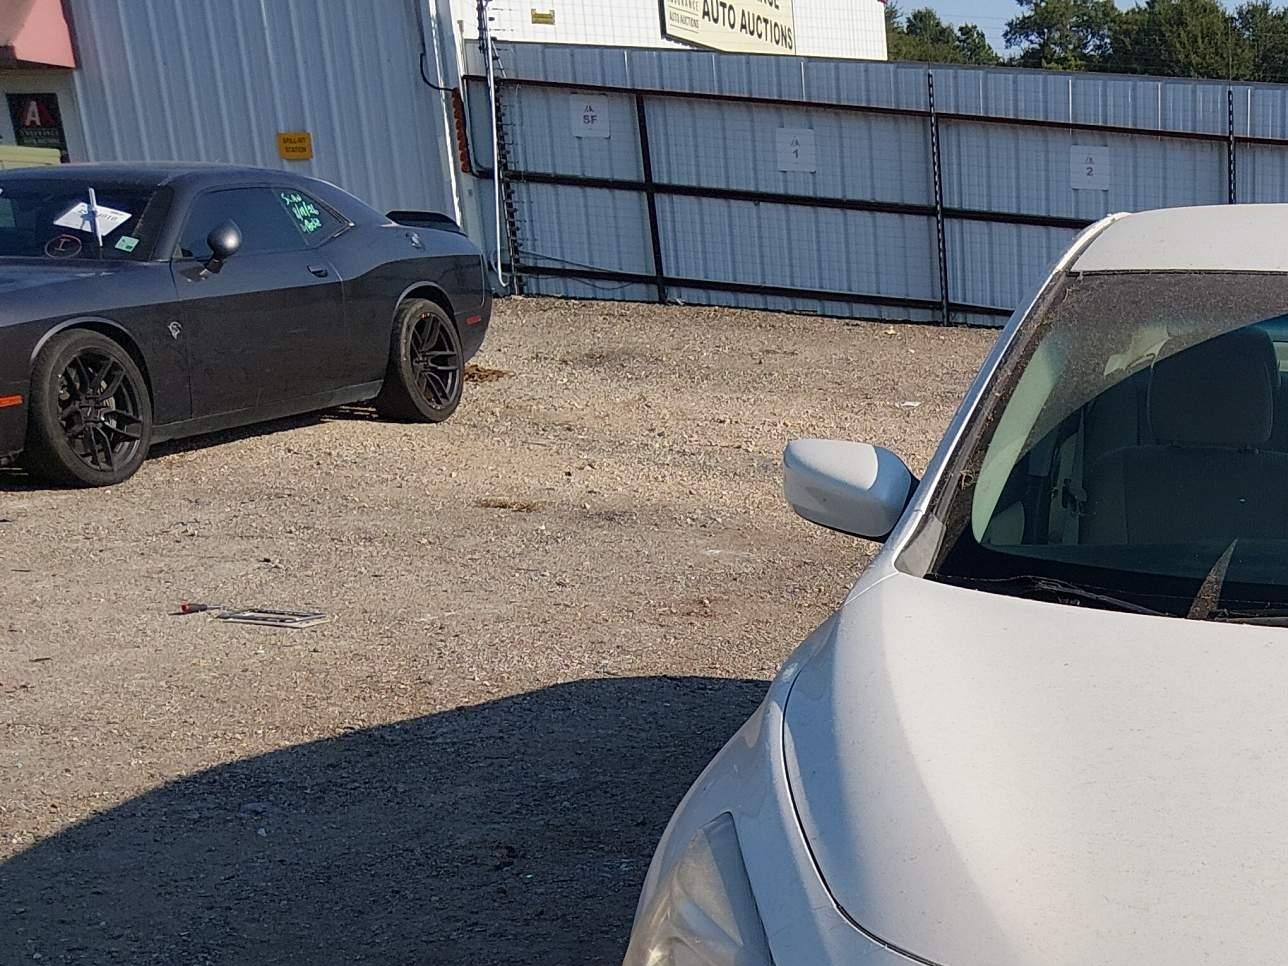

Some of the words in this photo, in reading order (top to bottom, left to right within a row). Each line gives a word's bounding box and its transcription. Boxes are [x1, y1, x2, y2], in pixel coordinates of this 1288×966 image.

[702, 0, 736, 29] AUTO
[740, 8, 793, 49] AUCTIONS
[792, 149, 799, 159] 1
[1086, 166, 1094, 177] 2
